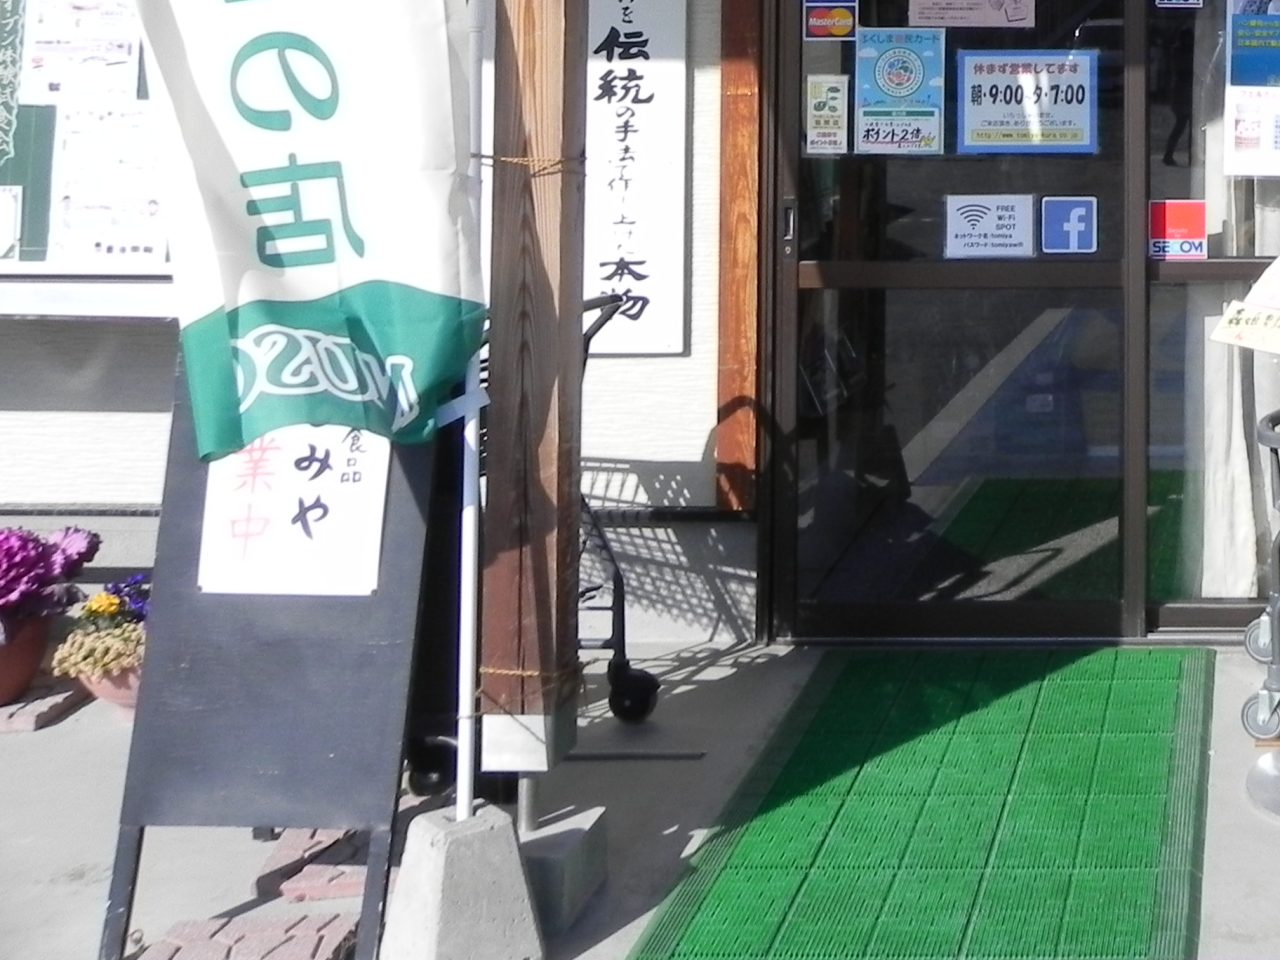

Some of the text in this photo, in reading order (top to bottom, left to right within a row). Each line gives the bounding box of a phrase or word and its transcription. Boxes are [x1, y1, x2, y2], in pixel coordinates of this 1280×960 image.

[808, 17, 853, 28] MasterCard
[973, 62, 1080, 75] 休まず営業してます
[1152, 240, 1203, 253] SEOM
